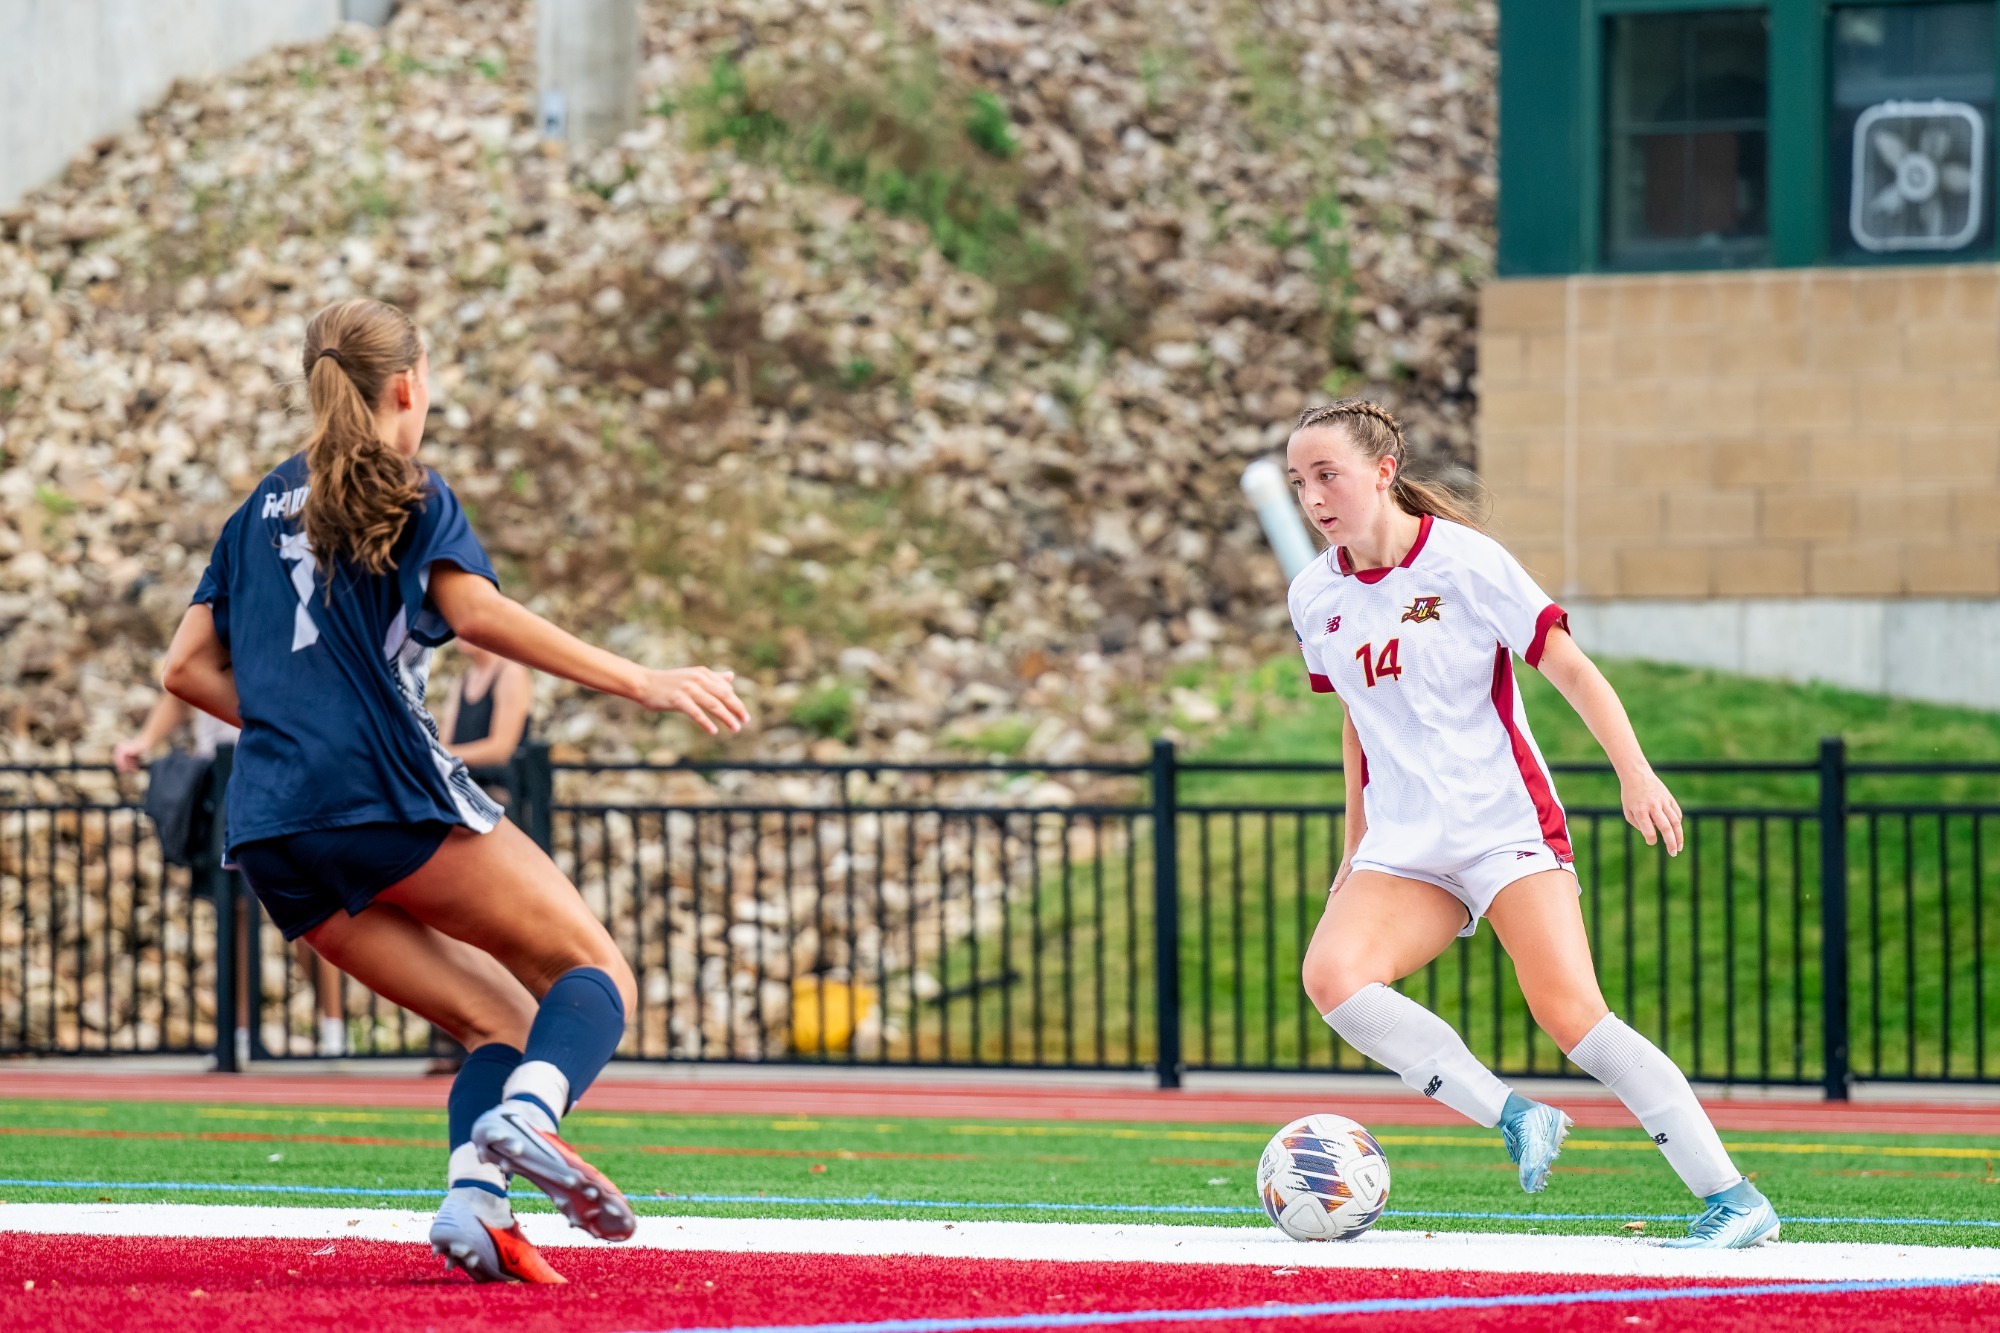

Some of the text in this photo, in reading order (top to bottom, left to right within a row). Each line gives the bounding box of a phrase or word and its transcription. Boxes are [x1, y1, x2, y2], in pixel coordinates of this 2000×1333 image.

[262, 486, 312, 520] RAID
[279, 531, 320, 652] 7
[1355, 638, 1402, 688] 14
